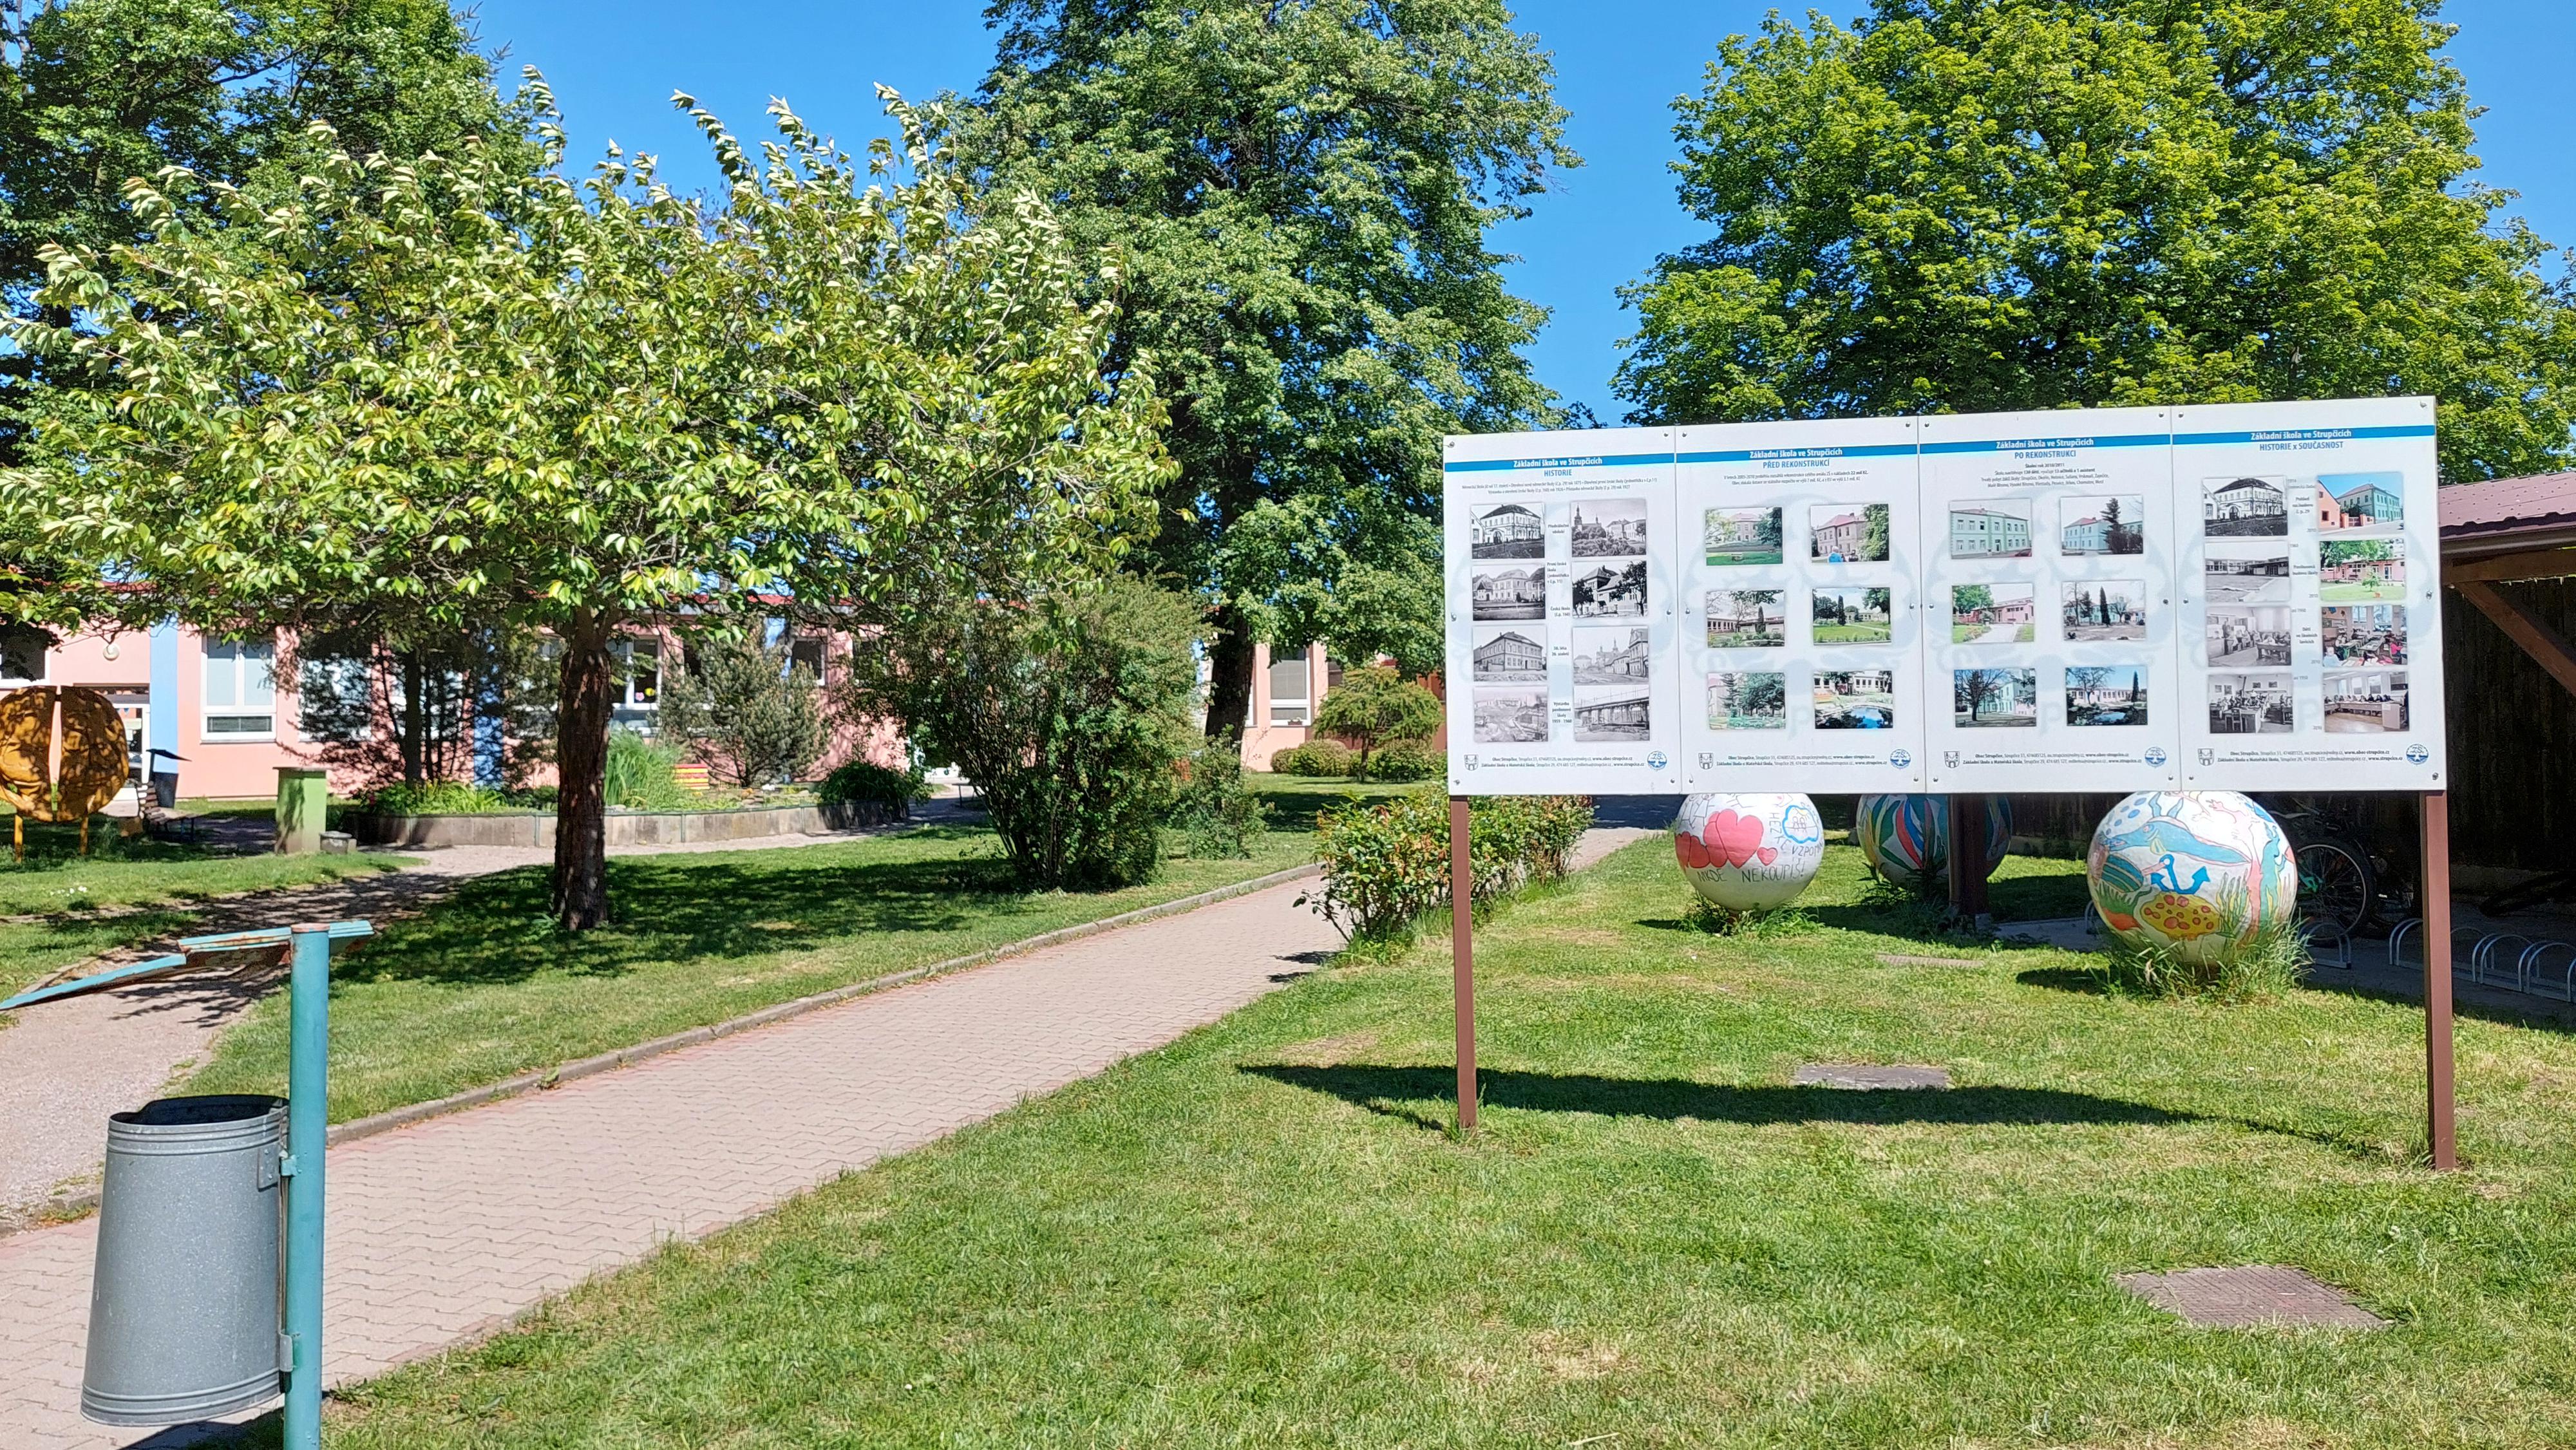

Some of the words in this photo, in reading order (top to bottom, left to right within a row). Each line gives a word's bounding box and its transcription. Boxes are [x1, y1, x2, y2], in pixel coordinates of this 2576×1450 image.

[2251, 432, 2281, 440] Základní
[2313, 429, 2352, 438] Strupčicích
[1997, 440, 2026, 448] Základní
[2056, 438, 2094, 447] Strupčicích
[2259, 442, 2291, 450] HISTORIE
[2299, 440, 2343, 450] SOUČASNOST
[1807, 448, 1843, 457] Strupčicích
[1568, 457, 1603, 466] Strupčicích
[1763, 460, 1779, 468] PŘED
[1781, 459, 1830, 468] REKONSTRUKCÍ
